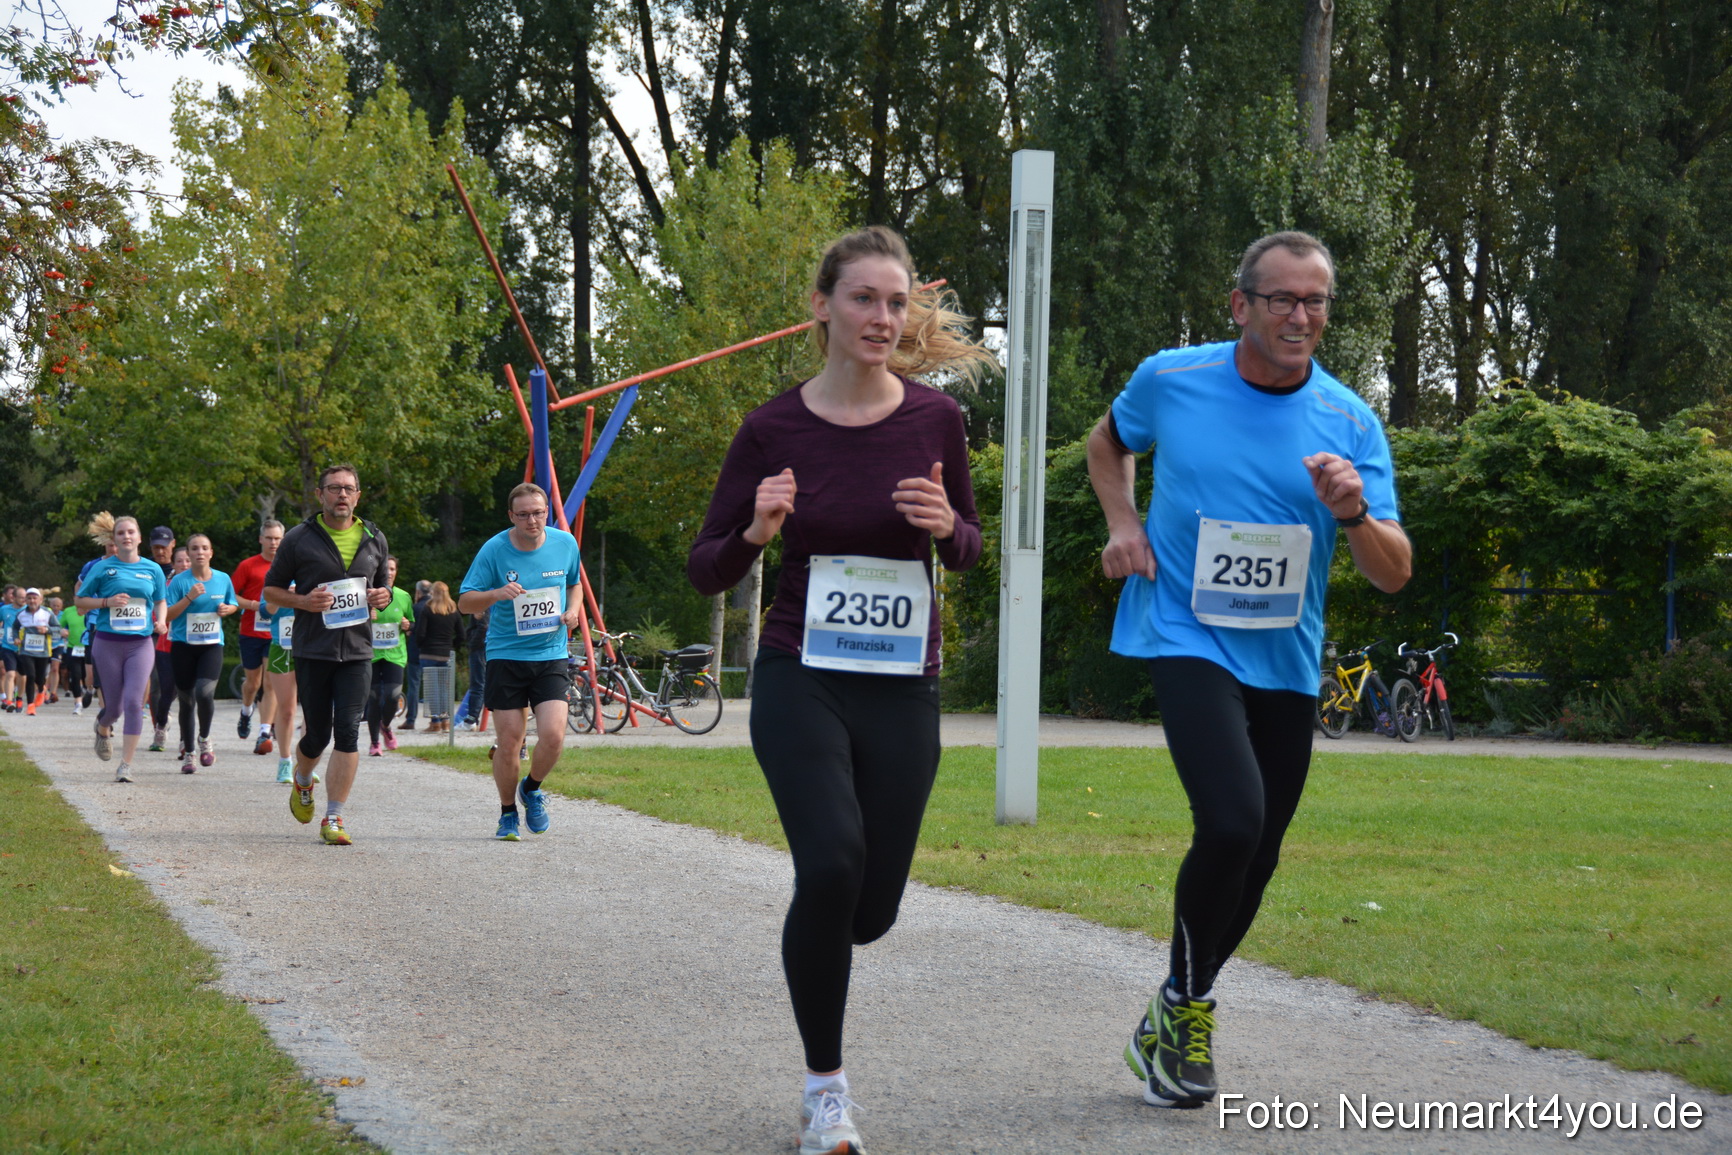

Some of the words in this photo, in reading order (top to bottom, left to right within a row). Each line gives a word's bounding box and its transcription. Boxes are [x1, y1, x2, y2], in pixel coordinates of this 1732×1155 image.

[1242, 533, 1281, 544] BOCK
[855, 567, 898, 579] BOCK
[1211, 553, 1288, 588] 2351
[329, 592, 360, 610] 2581
[1228, 597, 1270, 611] Johann
[115, 607, 142, 618] 2426
[521, 601, 555, 618] 2792
[825, 590, 912, 629] 2350
[191, 621, 216, 633] 2027
[518, 620, 553, 630] Thomas
[375, 630, 395, 639] 2185
[836, 636, 895, 653] Franziska
